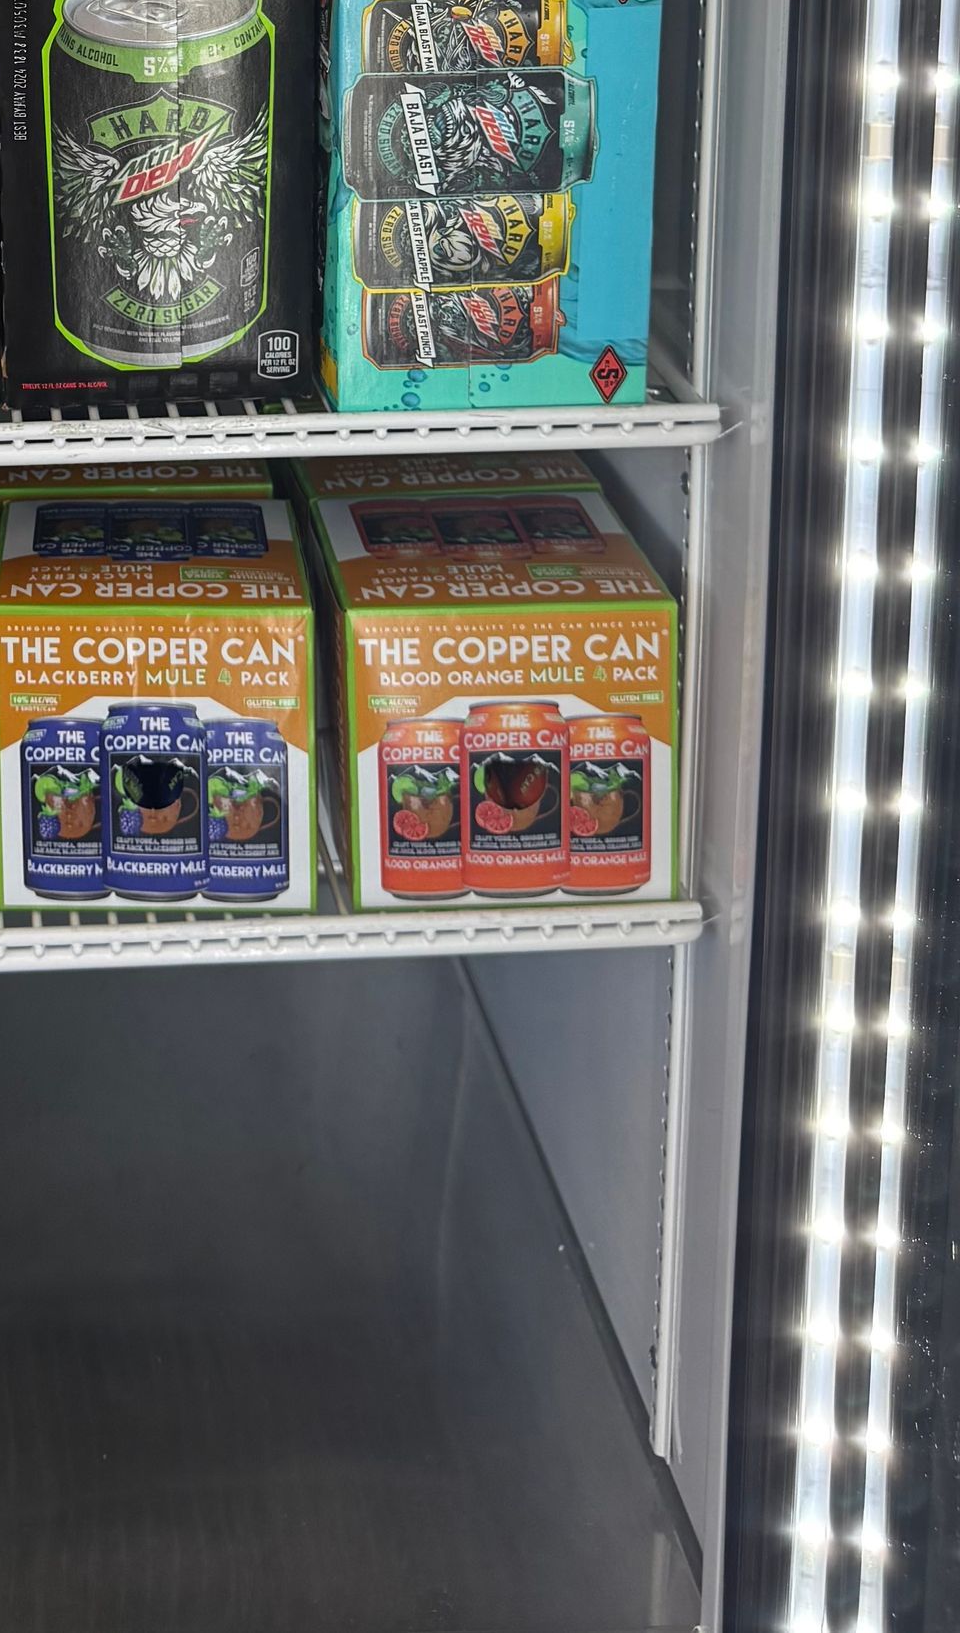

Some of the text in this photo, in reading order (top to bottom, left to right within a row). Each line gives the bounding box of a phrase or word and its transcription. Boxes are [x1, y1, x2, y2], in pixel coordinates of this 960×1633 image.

[405, 101, 435, 177] BAJA BLAST
[267, 336, 291, 351] 100
[1, 636, 295, 666] THE COPPER CAN
[359, 632, 660, 667] THE COPPER CAN
[15, 668, 289, 687] BLACKBERRY MULE 4 PACK
[380, 665, 658, 687] BLOOD ORANGE MULE 4 PACK
